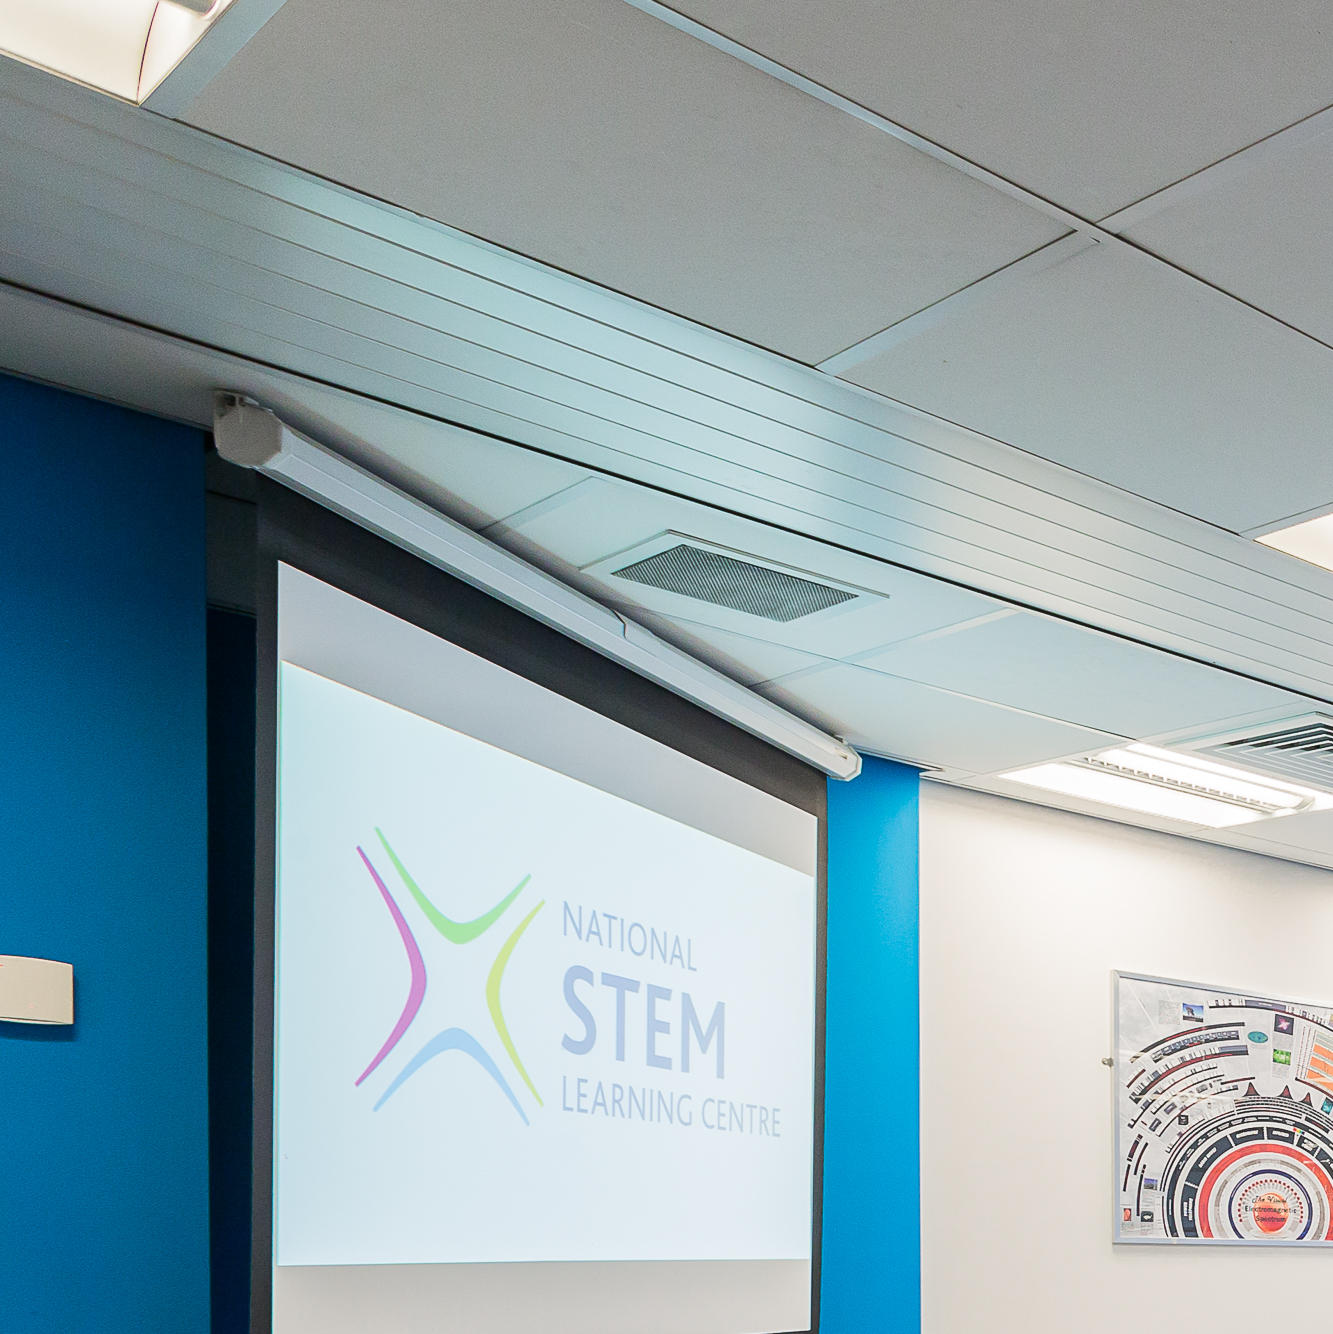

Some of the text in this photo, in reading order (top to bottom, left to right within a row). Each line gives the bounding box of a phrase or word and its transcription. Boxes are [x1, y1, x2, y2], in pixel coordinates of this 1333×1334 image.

[563, 900, 697, 972] NATIONAL
[561, 964, 725, 1080] STEM
[562, 1075, 781, 1138] LEARNING CENTRE
